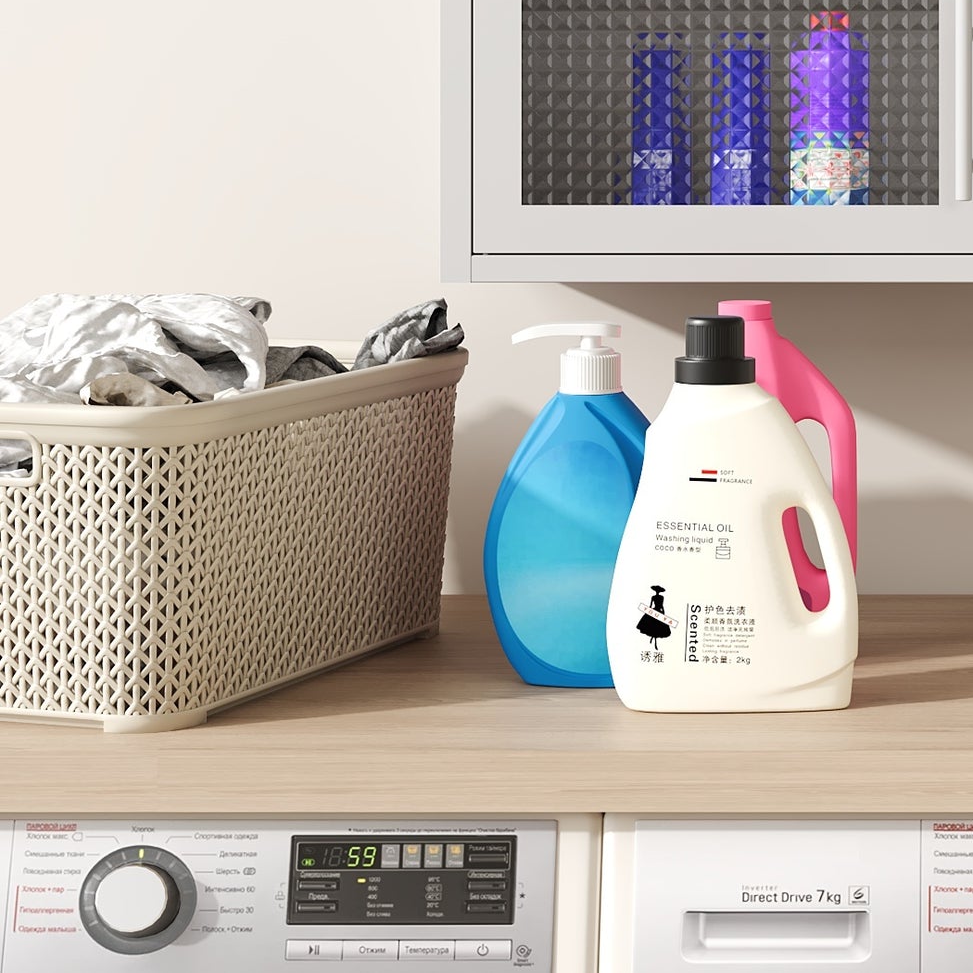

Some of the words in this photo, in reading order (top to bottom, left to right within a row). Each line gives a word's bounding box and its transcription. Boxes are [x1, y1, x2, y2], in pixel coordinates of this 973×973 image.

[656, 521, 714, 532] ESSENTIAL
[716, 523, 734, 533] OIL
[656, 534, 690, 544] Washing
[692, 536, 714, 545] liquid
[704, 605, 746, 616] 护色去渍
[688, 604, 702, 663] Scented
[640, 650, 664, 664] 诱雅
[736, 656, 751, 666] 2kg
[742, 892, 778, 903] Direct
[781, 892, 813, 903] Drive
[358, 946, 386, 954] Отжим
[404, 946, 450, 955] Температура
